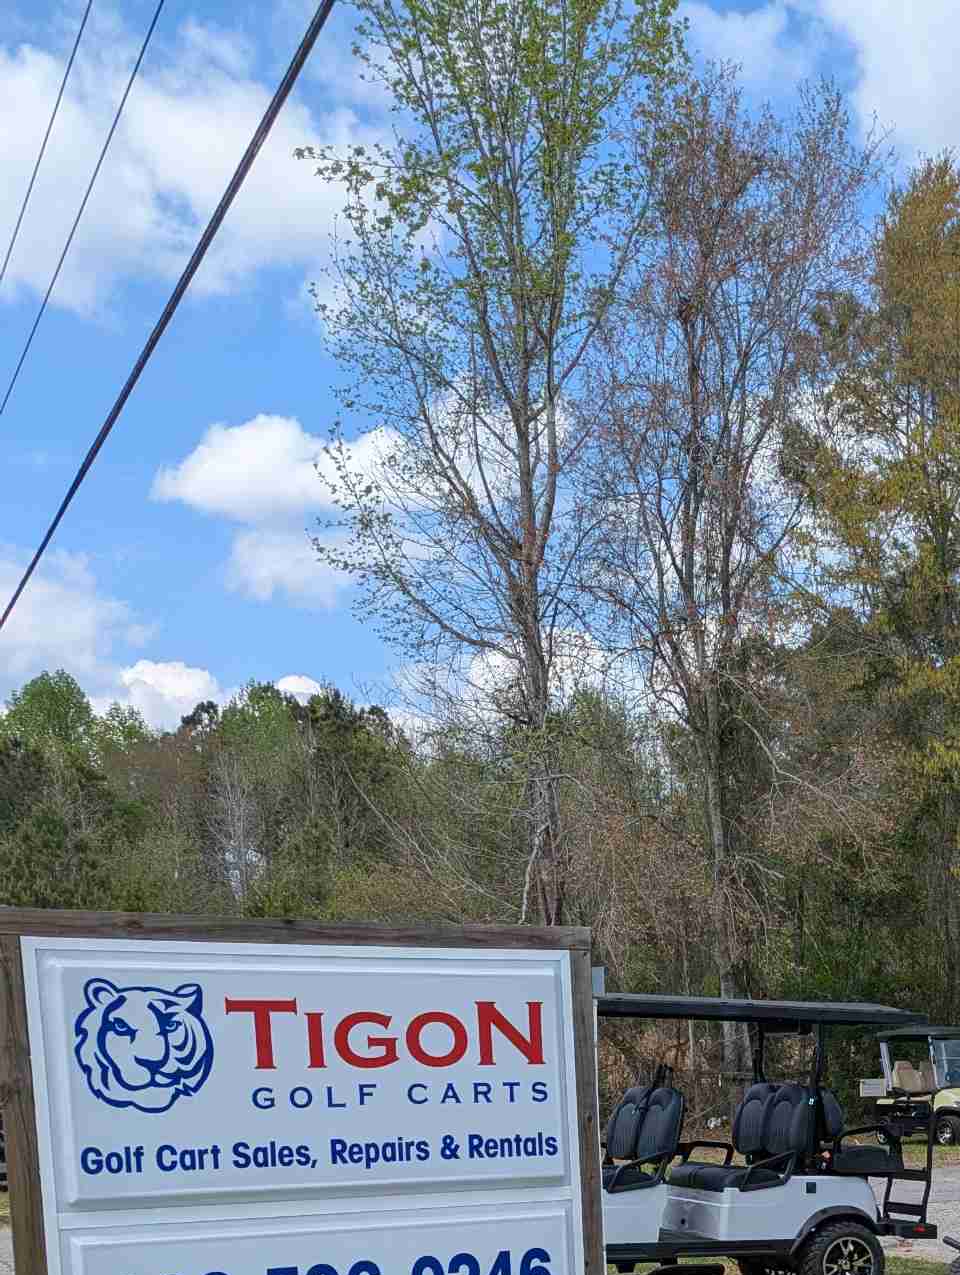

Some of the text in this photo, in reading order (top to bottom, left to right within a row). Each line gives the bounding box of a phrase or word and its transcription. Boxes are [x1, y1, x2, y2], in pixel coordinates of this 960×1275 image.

[224, 997, 546, 1070] TIGON
[251, 1081, 549, 1110] GOLF CARTS
[80, 1131, 559, 1175] Golf Cart Sales, Repairs & Rentals
